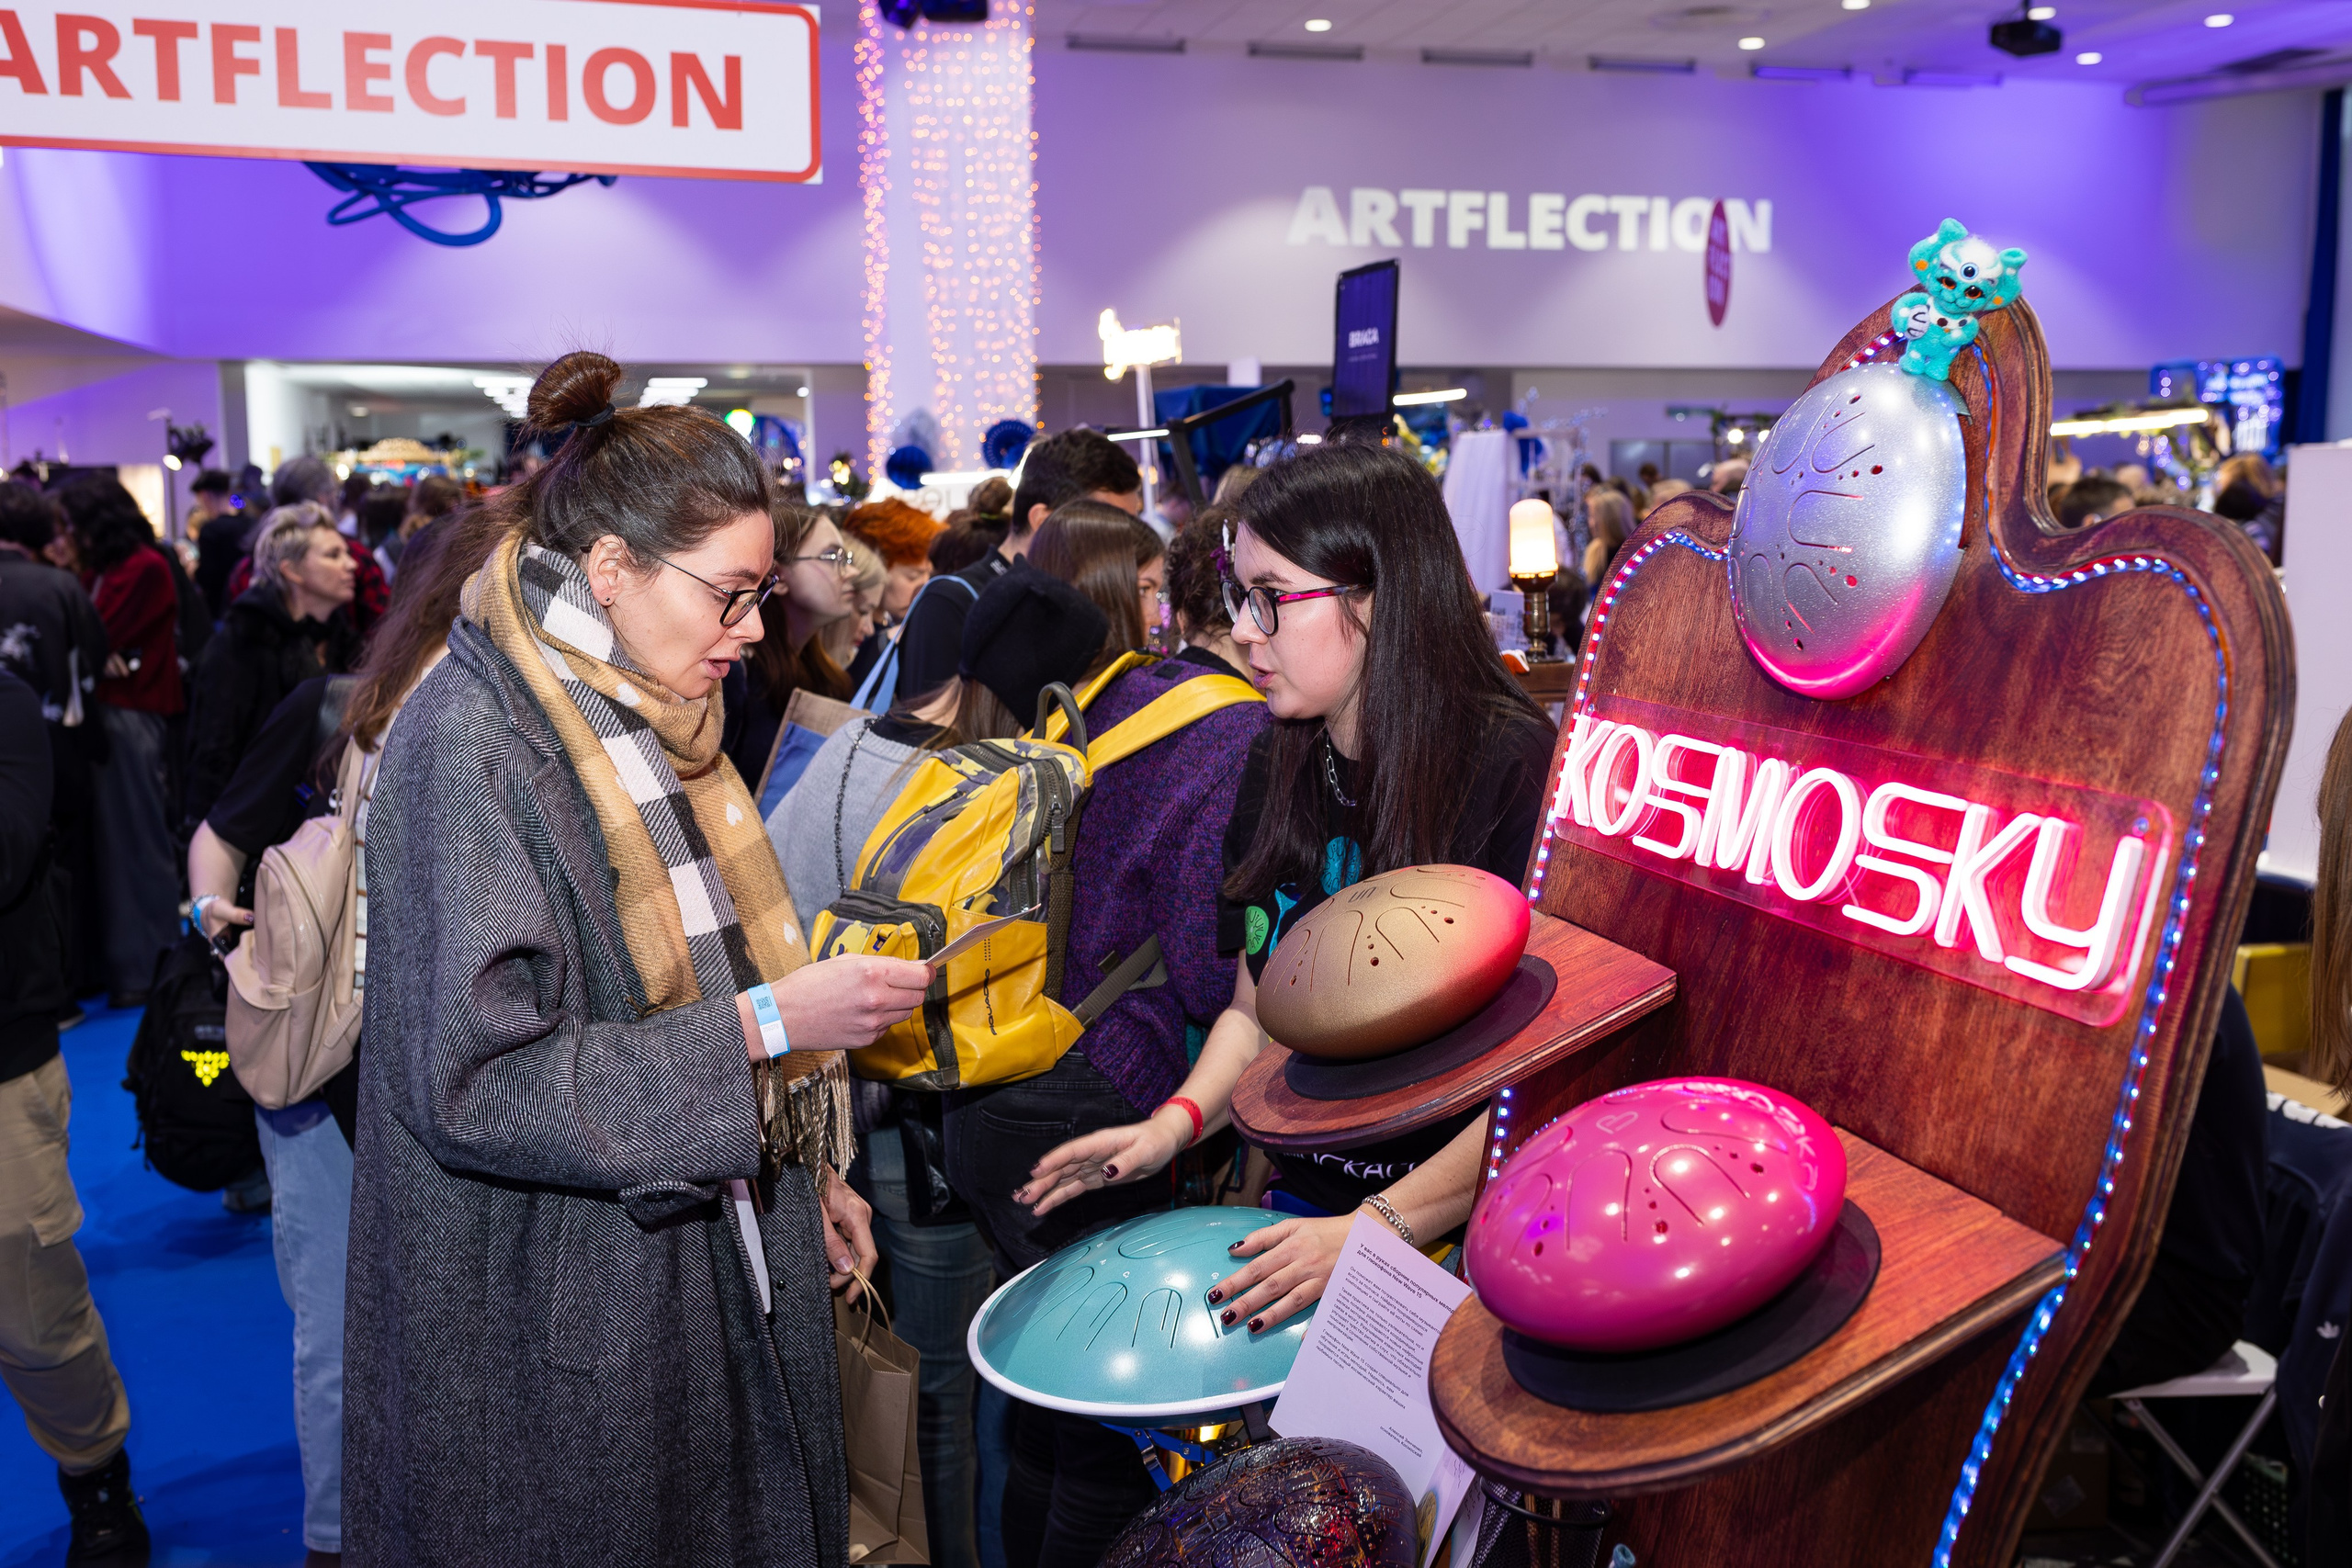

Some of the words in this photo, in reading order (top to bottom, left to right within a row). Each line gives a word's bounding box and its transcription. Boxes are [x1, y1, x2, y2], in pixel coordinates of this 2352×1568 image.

[0, 9, 742, 130] ARTFLECTION
[1286, 186, 1772, 254] ARTFLECTION
[1554, 713, 2144, 991] KOSMOSKY
[1438, 1300, 1455, 1316] мелод
